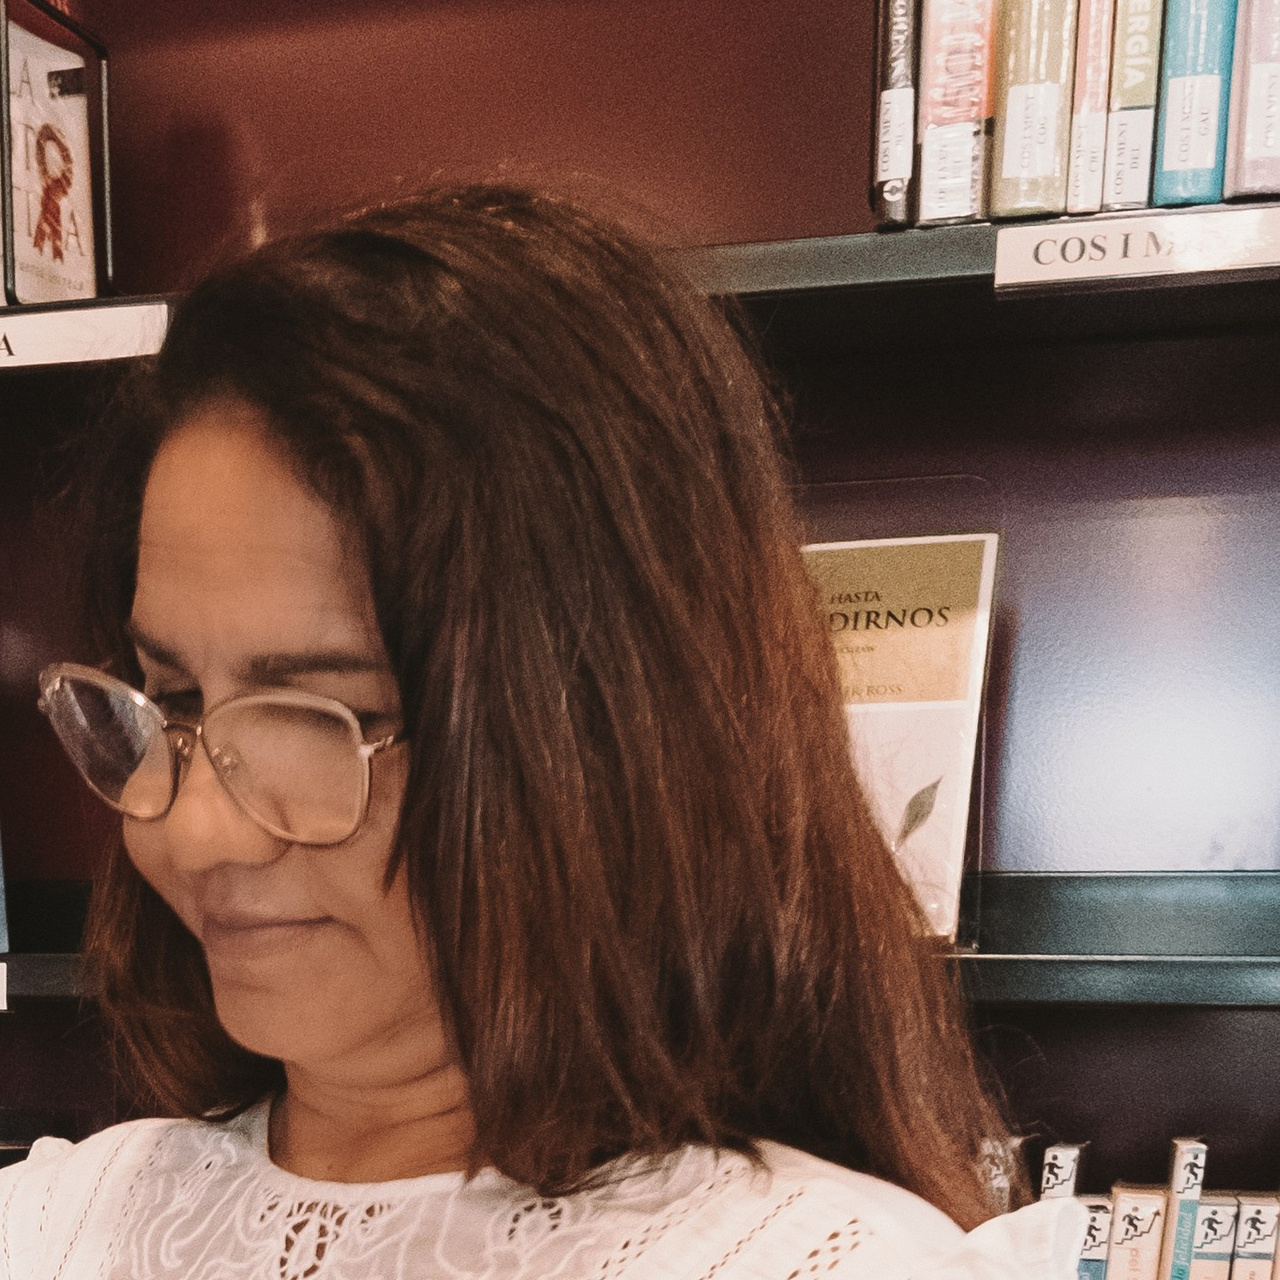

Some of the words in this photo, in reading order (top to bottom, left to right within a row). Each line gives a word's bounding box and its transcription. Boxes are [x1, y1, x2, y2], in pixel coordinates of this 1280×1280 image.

[1122, 0, 1154, 90] ERGÍA
[1031, 233, 1108, 267] COS
[829, 590, 881, 605] HASTA
[828, 605, 951, 632] DIRNOS
[1174, 1211, 1194, 1266] felicidad
